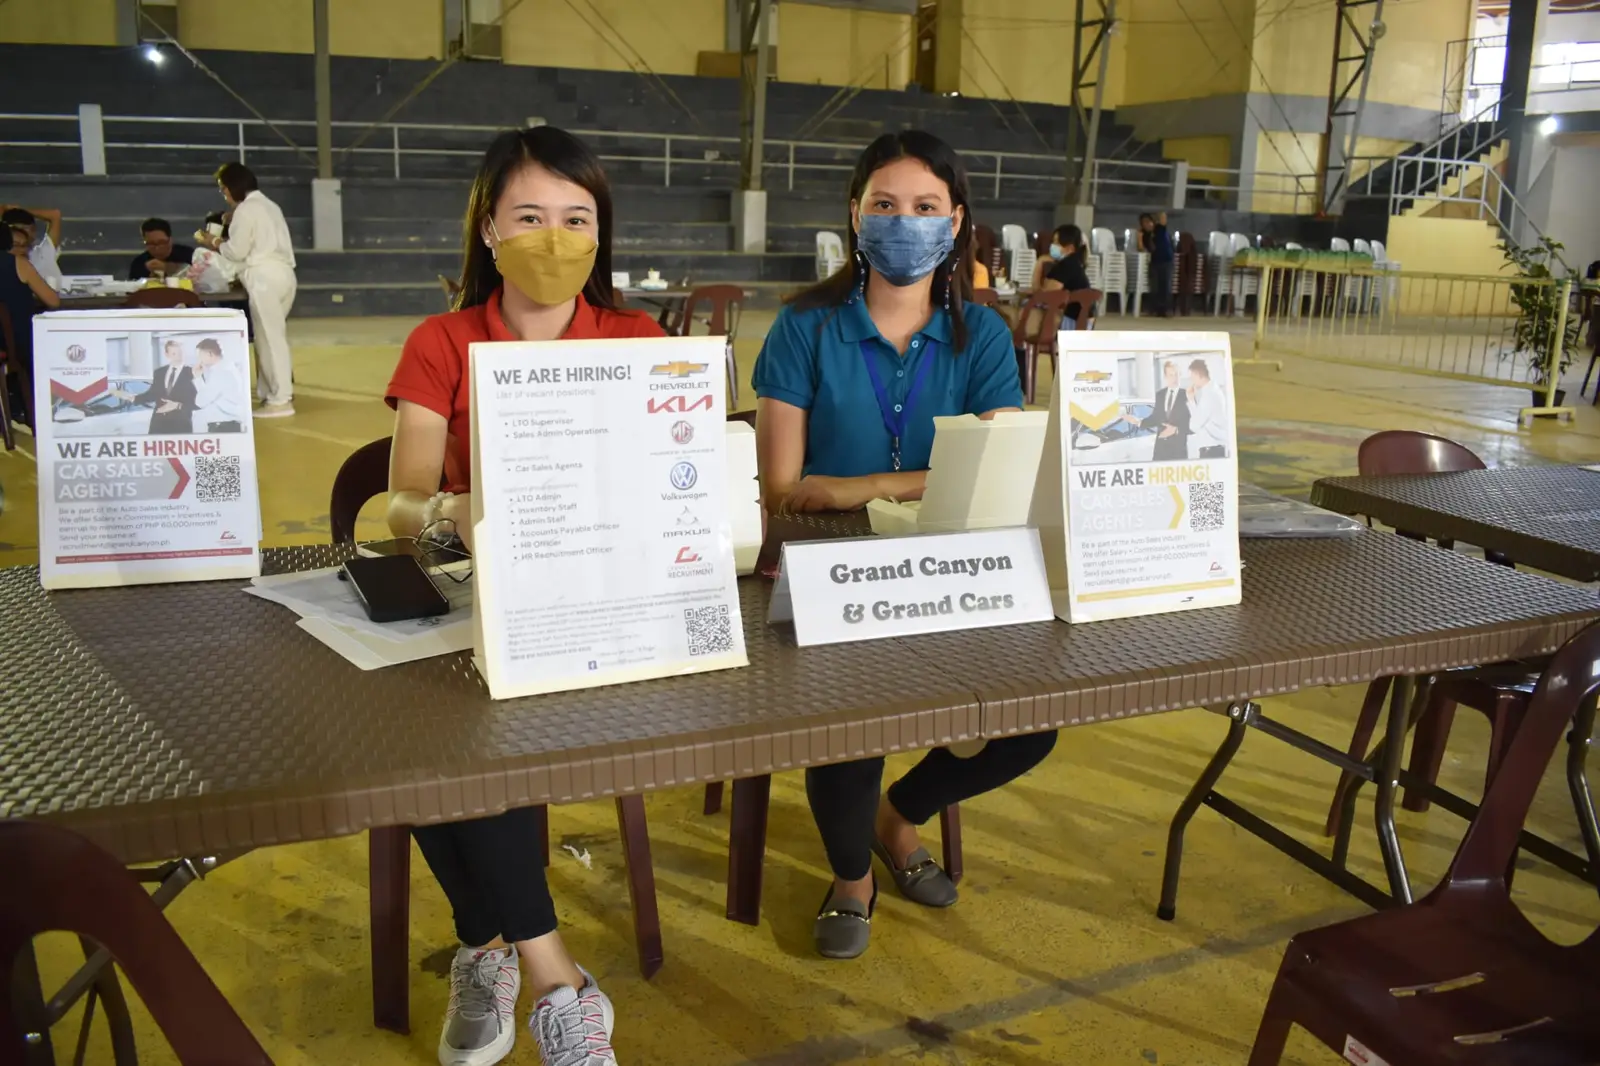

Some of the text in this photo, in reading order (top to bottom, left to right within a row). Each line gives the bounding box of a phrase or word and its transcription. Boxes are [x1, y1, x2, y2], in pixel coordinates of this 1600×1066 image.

[493, 364, 632, 385] WE ARE HIRING!
[649, 381, 711, 391] CHEVROLET
[1073, 386, 1114, 394] CHEVROLET
[526, 388, 554, 398] vacant
[646, 394, 713, 414] KIA
[512, 418, 574, 428] LTO Supervisor
[513, 427, 610, 440] Sales Admin Operations
[57, 438, 221, 459] WE ARE HIRING!
[58, 462, 164, 480] CAR SALES
[515, 462, 583, 473] Car Sales Agents
[1078, 464, 1210, 488] WE ARE HIRING!
[58, 482, 138, 500] AGENTS
[517, 492, 562, 502] LTO Admin
[660, 492, 708, 502] Volkswagen
[1080, 489, 1166, 511] CAR SALES
[79, 508, 95, 516] part
[518, 502, 578, 515] Inventory Staff
[92, 514, 116, 523] Salary
[126, 514, 170, 522] Commission
[519, 514, 566, 526] Admin Staff
[1081, 513, 1144, 532] AGENTS
[78, 526, 88, 534] up
[520, 523, 620, 538] Accounts Payable Officer
[80, 534, 98, 542] your
[520, 539, 562, 549] HR Officer
[522, 546, 614, 560] HR Recruitment Officer
[667, 567, 714, 579] RECRUITMENT
[830, 554, 1013, 584] Grand Canyon
[842, 592, 1015, 624] & Grand Cars
